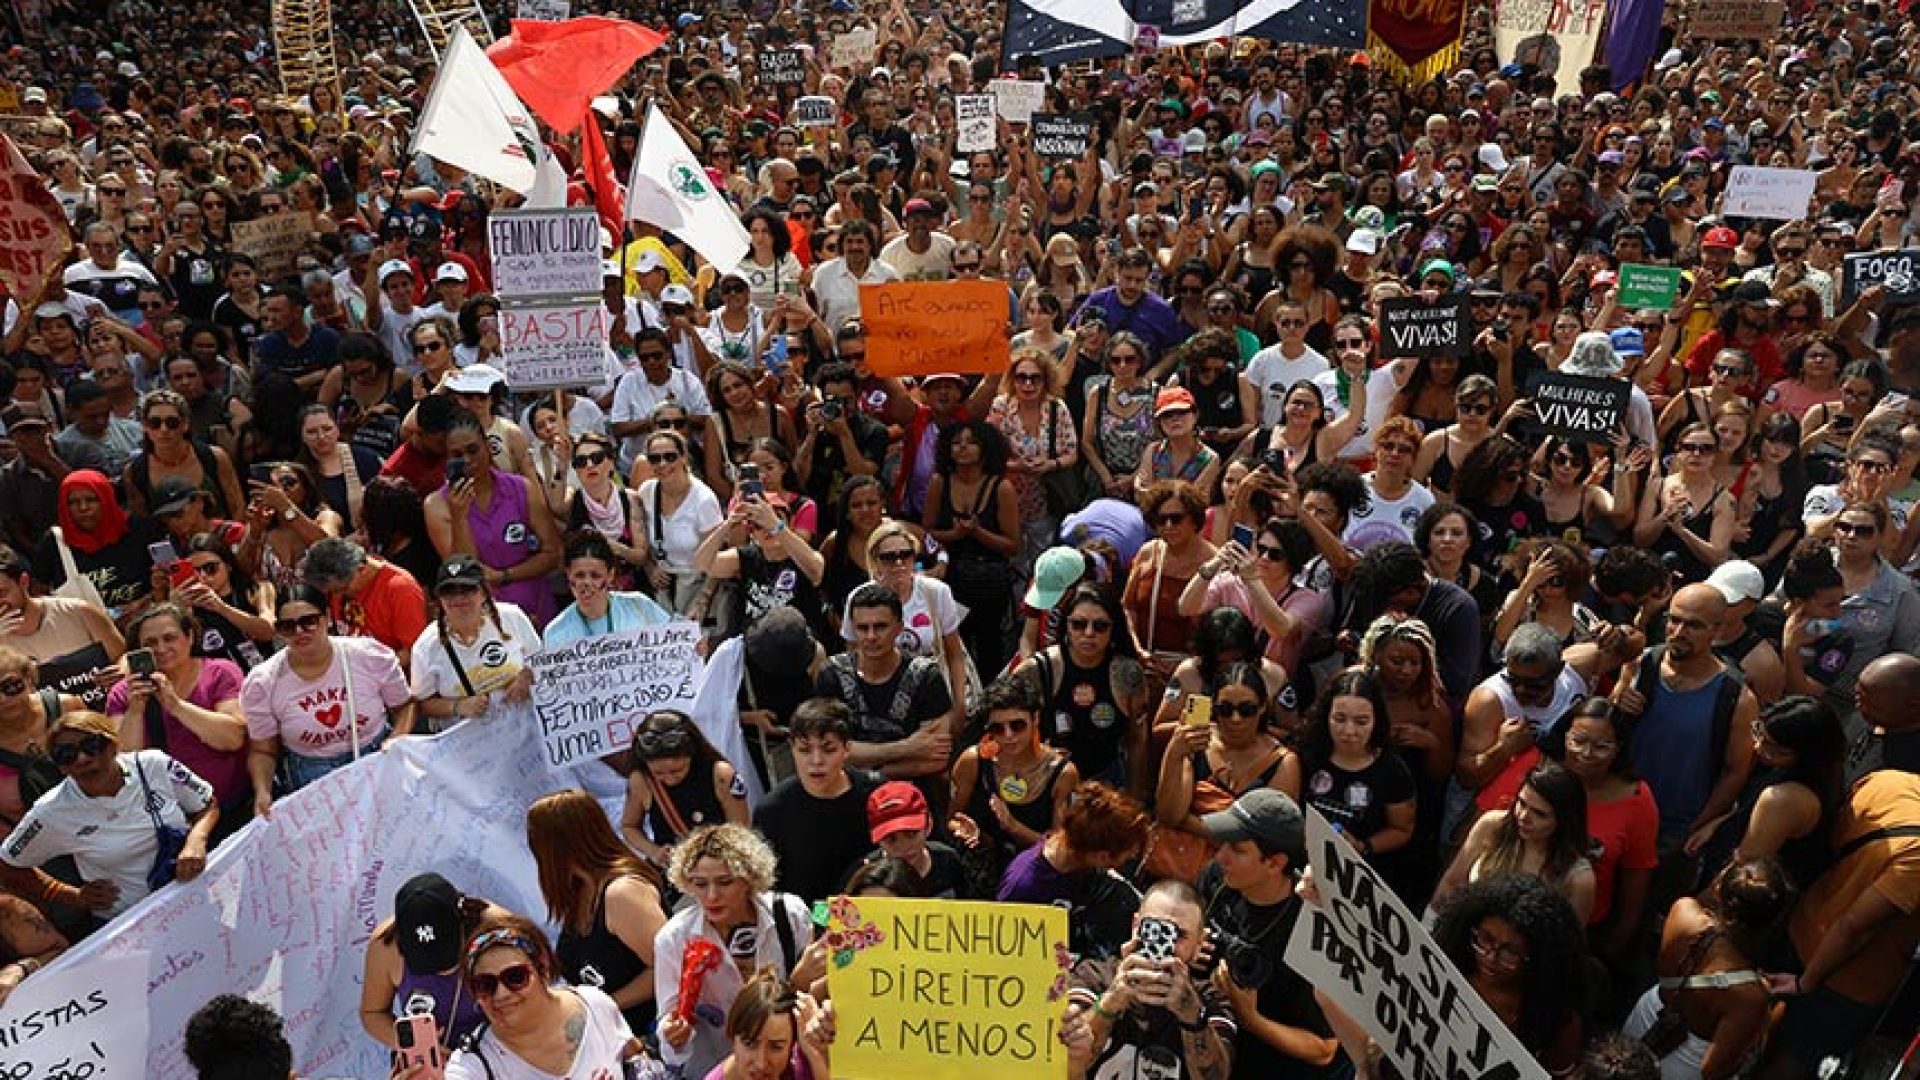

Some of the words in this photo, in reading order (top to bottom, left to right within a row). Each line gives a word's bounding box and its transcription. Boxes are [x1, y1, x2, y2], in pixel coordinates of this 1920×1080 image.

[490, 215, 599, 256] FEMINICÍDIO
[1390, 320, 1457, 349] VIVAS!
[1538, 384, 1616, 407] MULHERES
[1535, 402, 1617, 434] VIVAS!
[1324, 840, 1410, 956] NÃO
[893, 914, 1048, 959] NENHUM
[1312, 910, 1365, 995] POR
[855, 1016, 882, 1050] A
